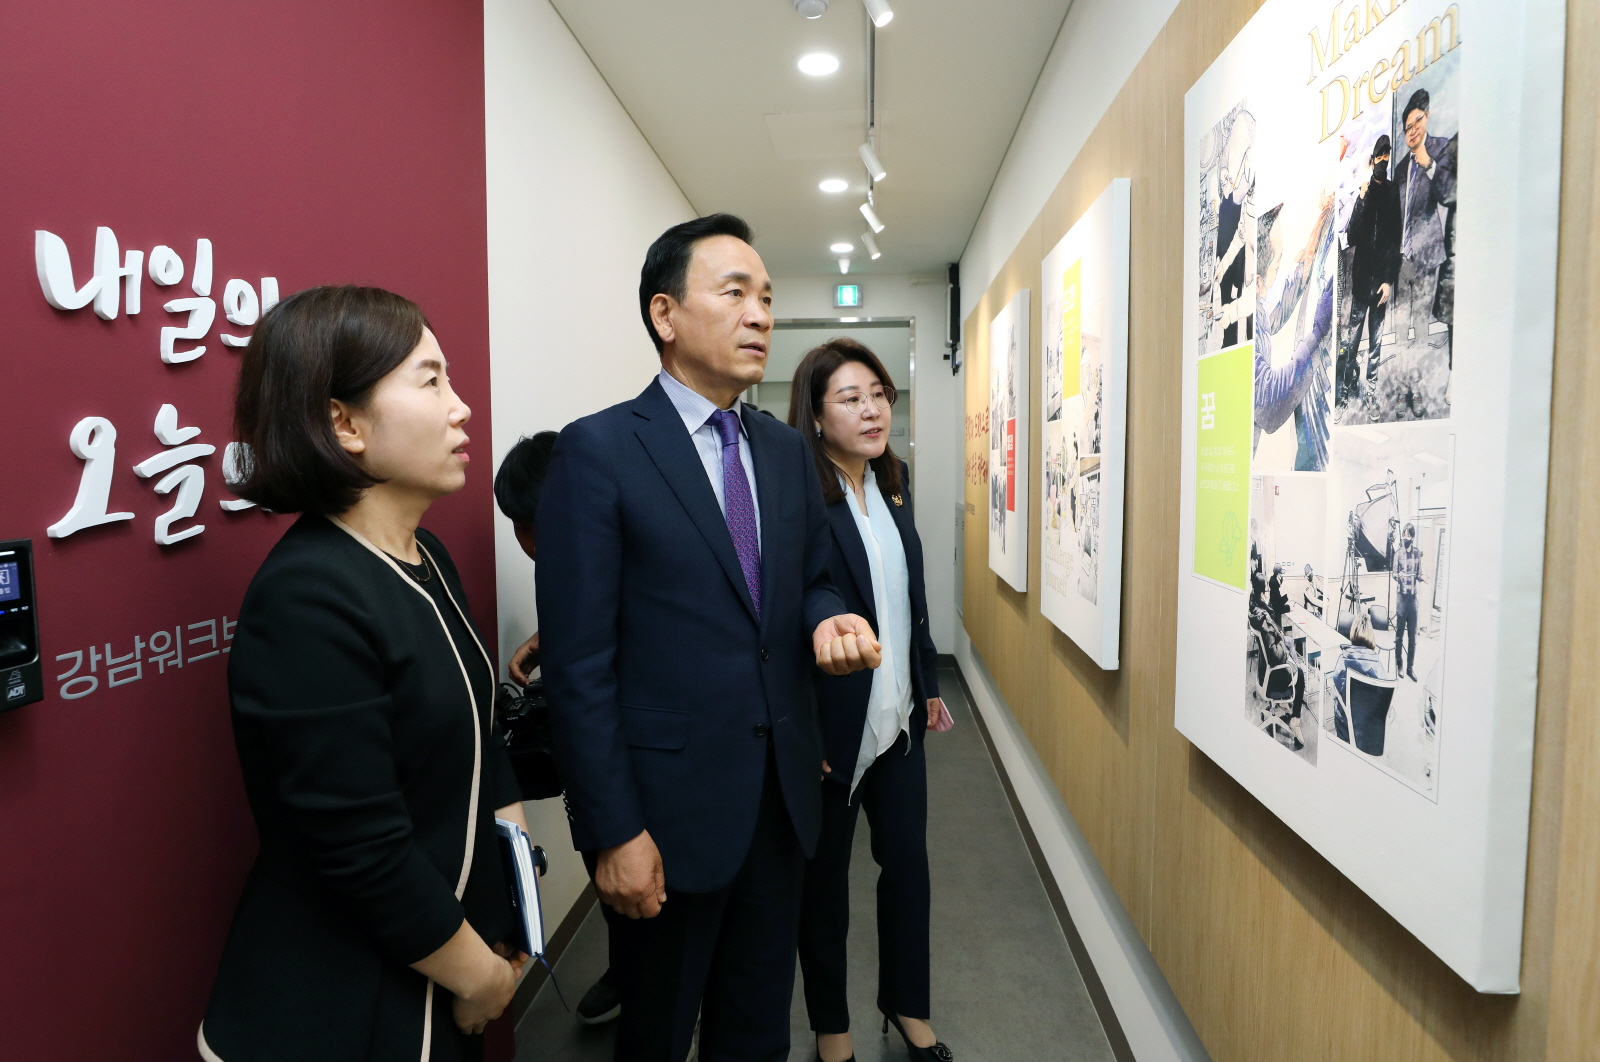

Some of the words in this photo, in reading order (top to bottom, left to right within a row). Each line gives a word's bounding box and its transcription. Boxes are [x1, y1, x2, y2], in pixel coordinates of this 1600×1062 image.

[1307, 0, 1407, 86] Mak
[1319, 2, 1462, 144] Dream
[35, 226, 280, 364] 내일의
[1200, 391, 1216, 430] 꿈
[8, 685, 25, 699] ADT
